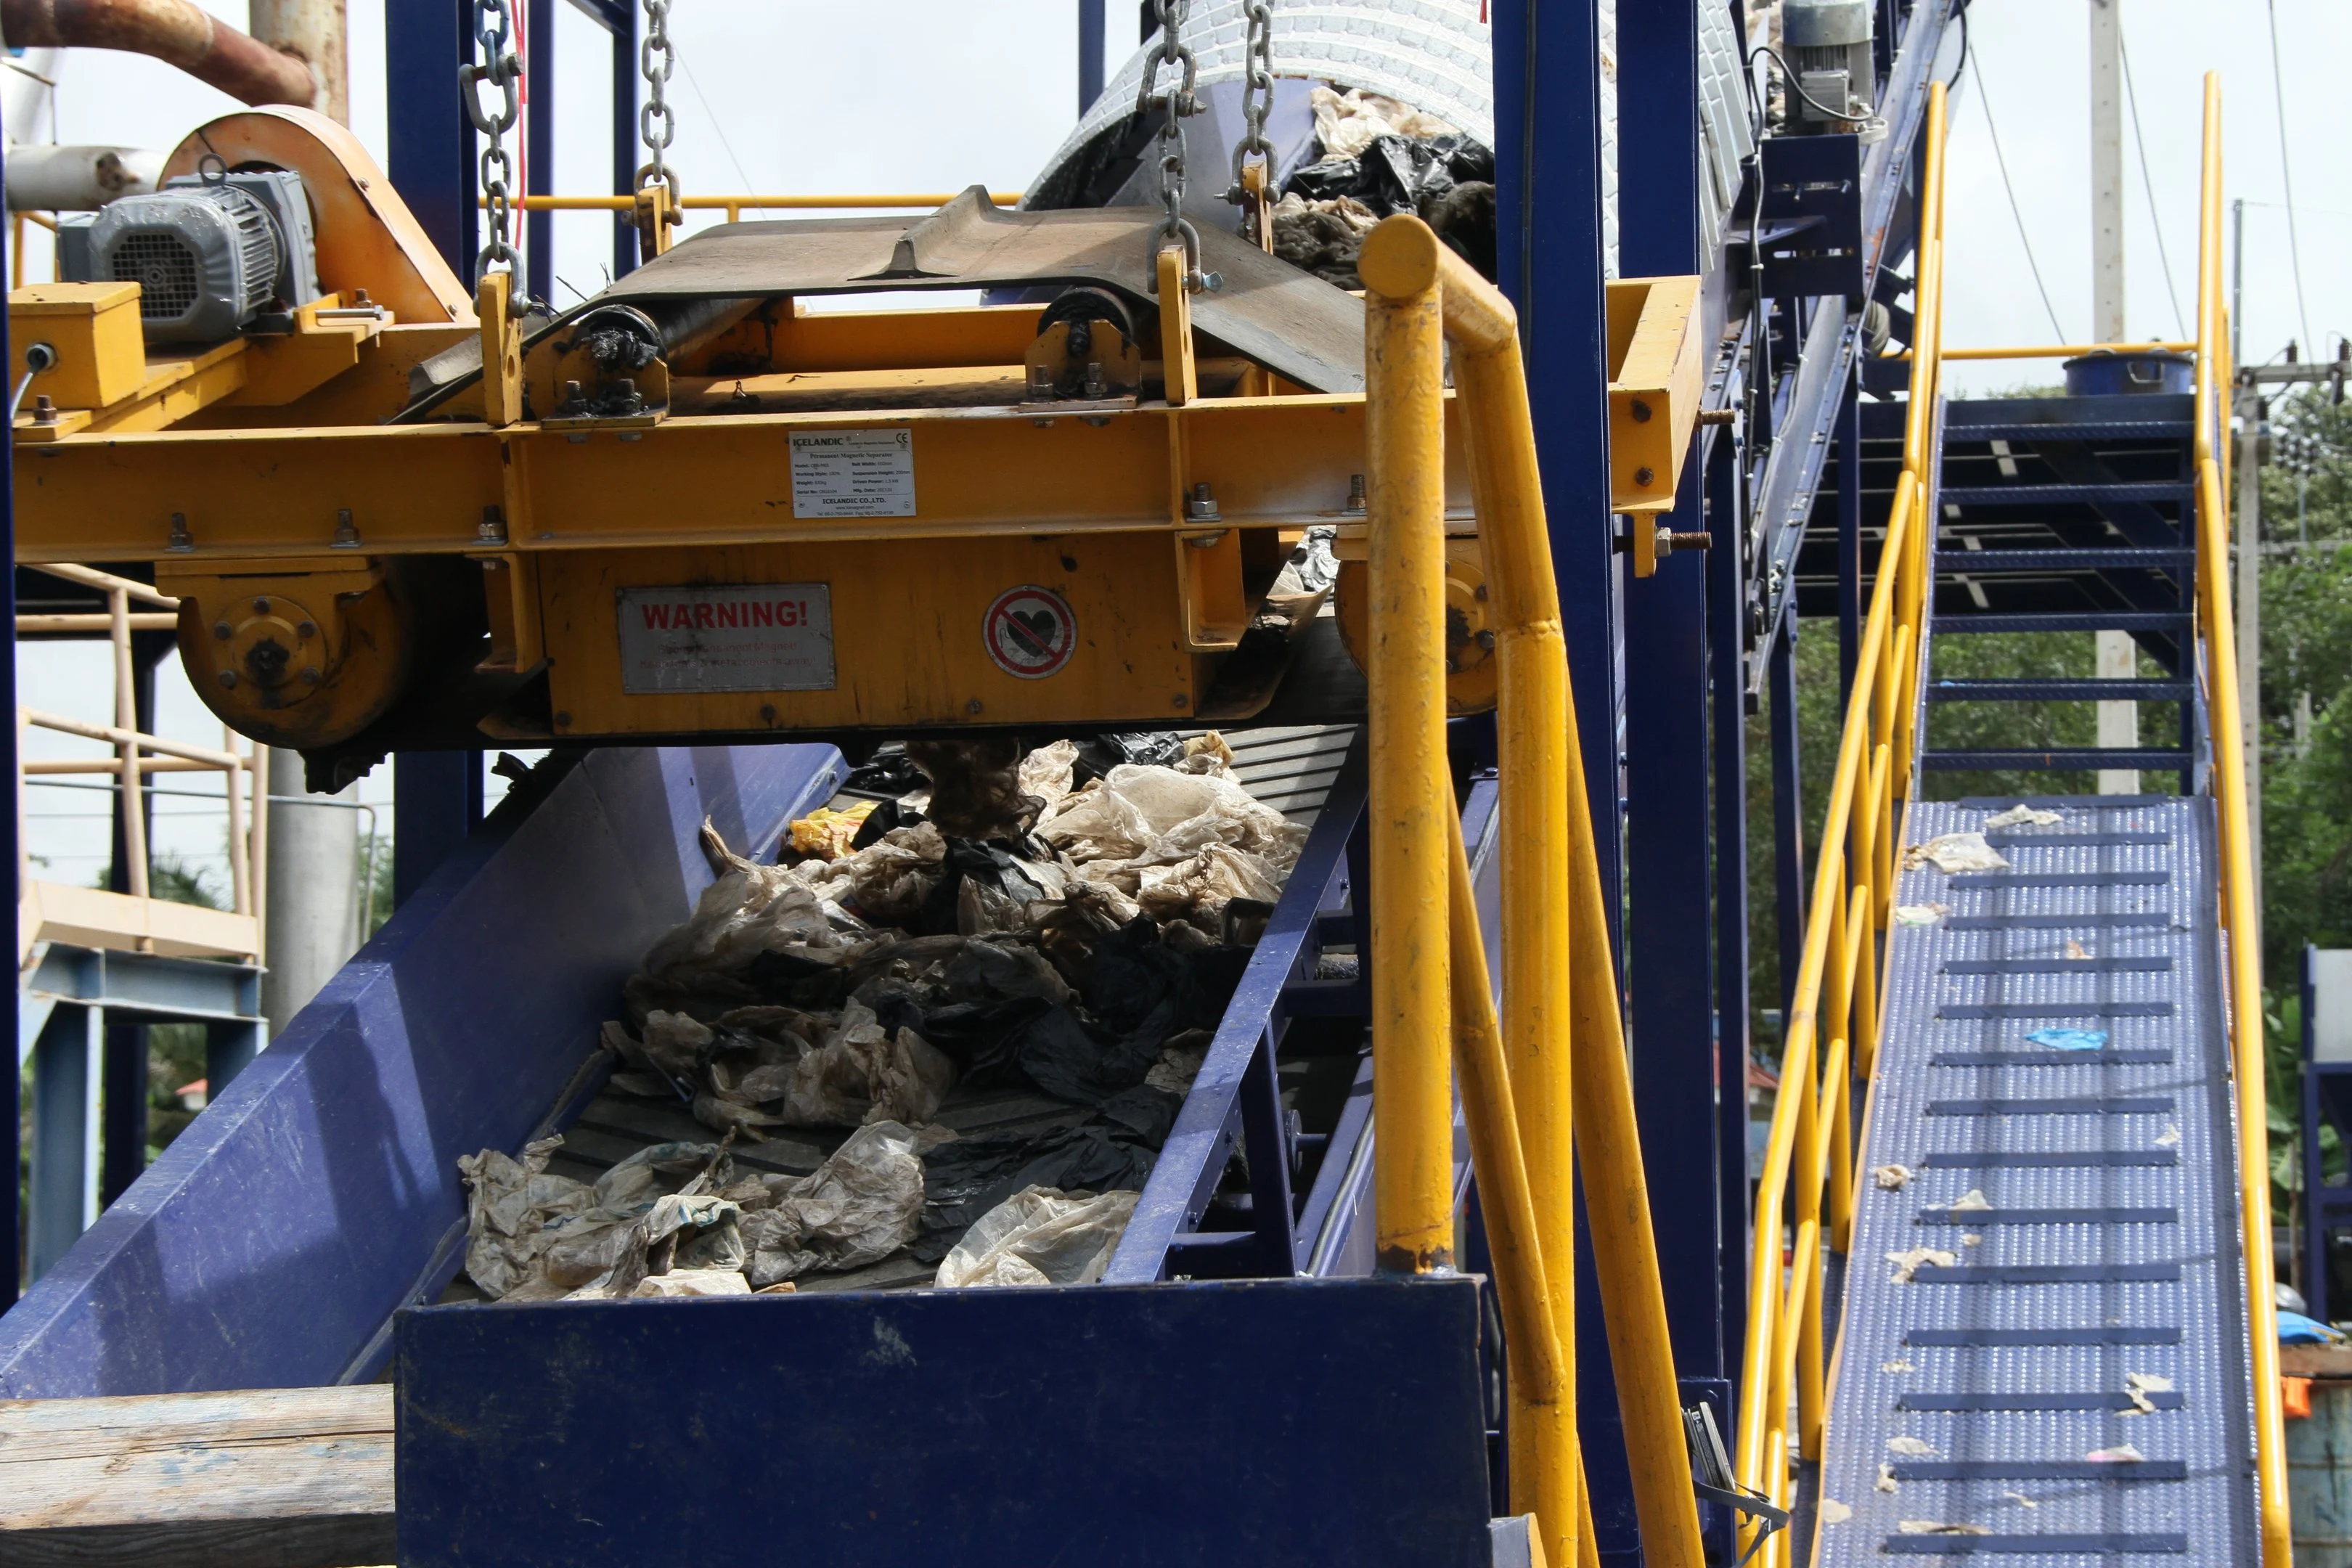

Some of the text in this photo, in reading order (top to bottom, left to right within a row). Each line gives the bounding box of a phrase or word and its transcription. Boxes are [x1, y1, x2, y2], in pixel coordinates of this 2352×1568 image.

[793, 438, 844, 446] ICELANDIC
[642, 600, 809, 630] WARNING!
[695, 643, 752, 653] ermanent
